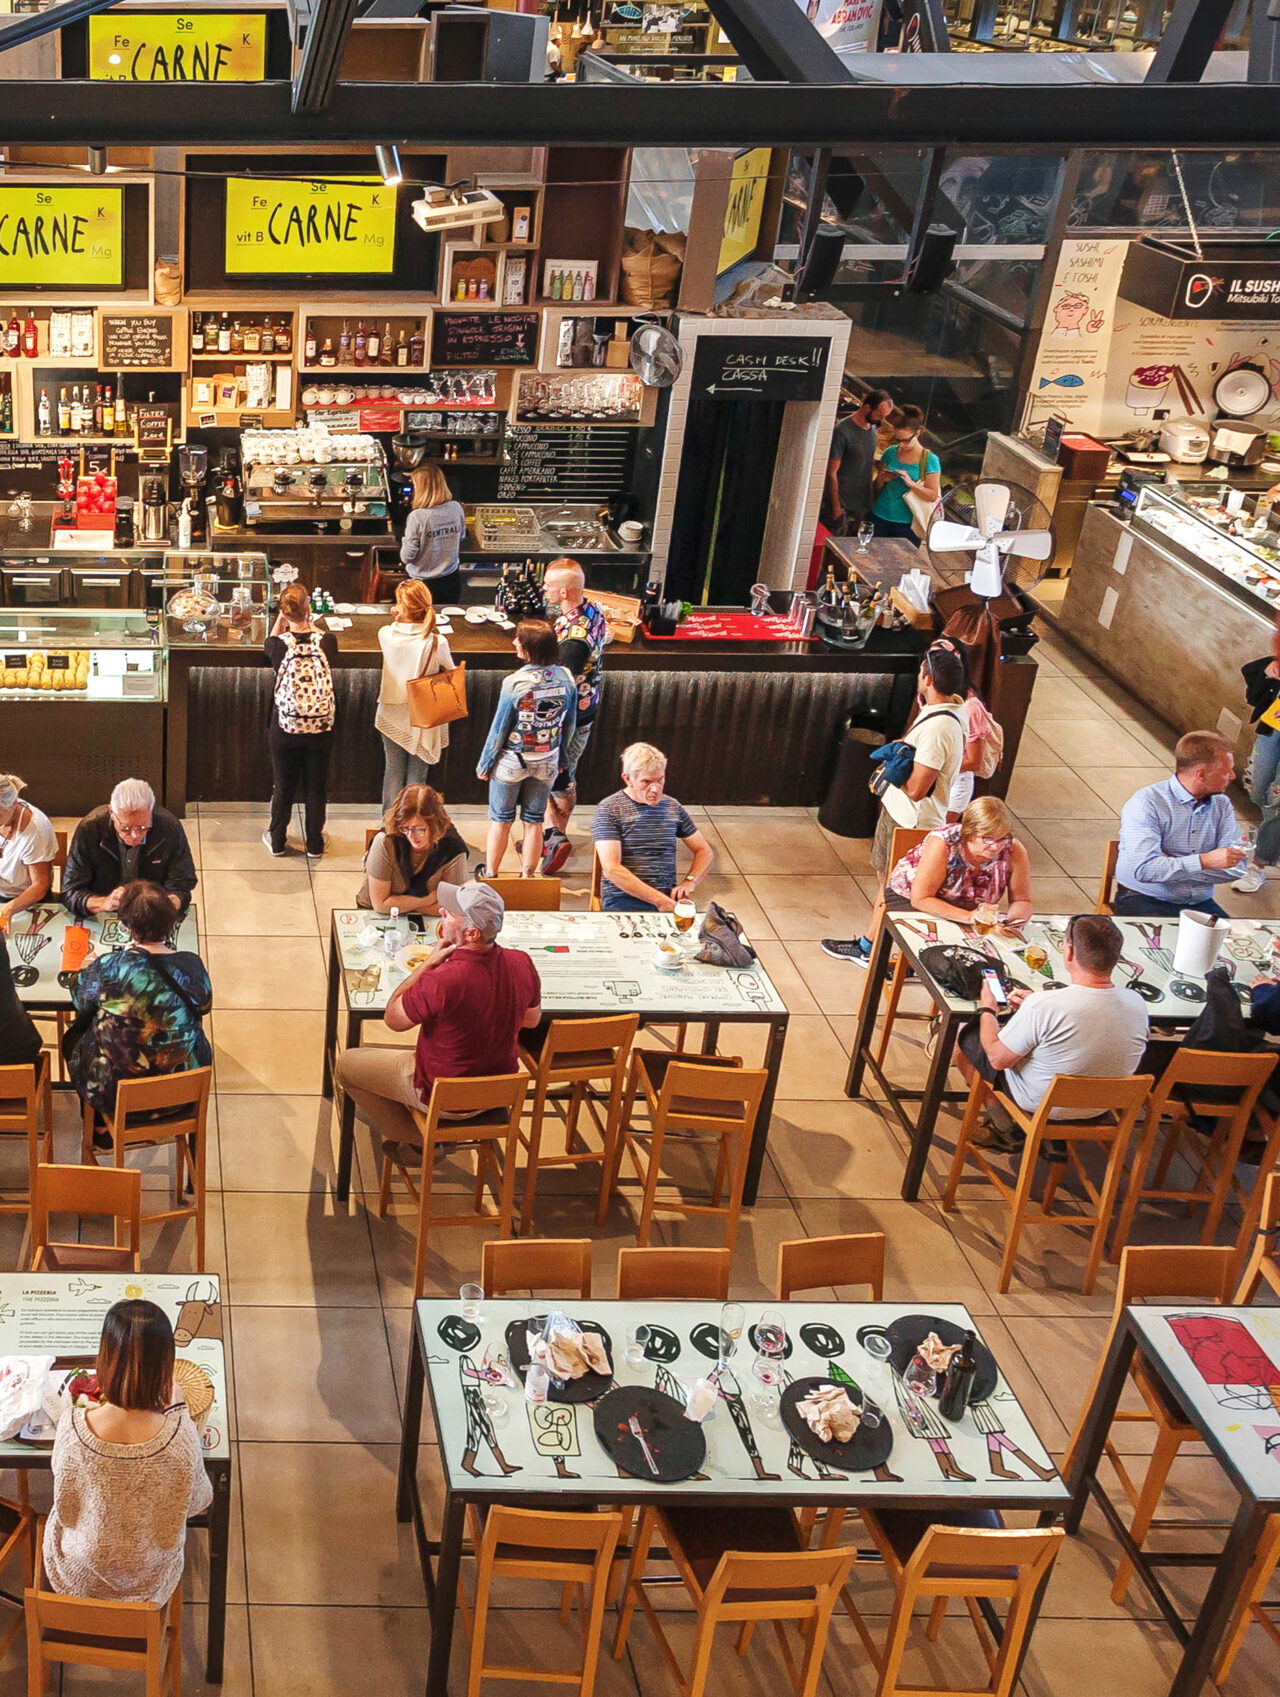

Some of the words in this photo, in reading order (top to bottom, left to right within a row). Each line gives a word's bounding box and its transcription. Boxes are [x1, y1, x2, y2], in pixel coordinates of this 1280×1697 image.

[176, 18, 194, 30] Se
[114, 35, 130, 48] Fe
[242, 34, 251, 46] K
[131, 41, 232, 80] CARNE
[311, 181, 327, 192] Se
[36, 192, 52, 204] Se
[252, 196, 268, 207] Fe
[372, 194, 380, 205] K
[98, 207, 105, 218] K
[268, 201, 363, 248] CARNE
[236, 231, 252, 242] vit
[256, 232, 264, 242] B
[363, 234, 384, 247] Mg
[92, 246, 112, 258] Mg
[1069, 258, 1104, 268] SASHIMI
[1230, 280, 1243, 292] IL
[726, 353, 767, 366] CASH
[722, 369, 768, 381] CASSA
[139, 409, 166, 417] FILTER
